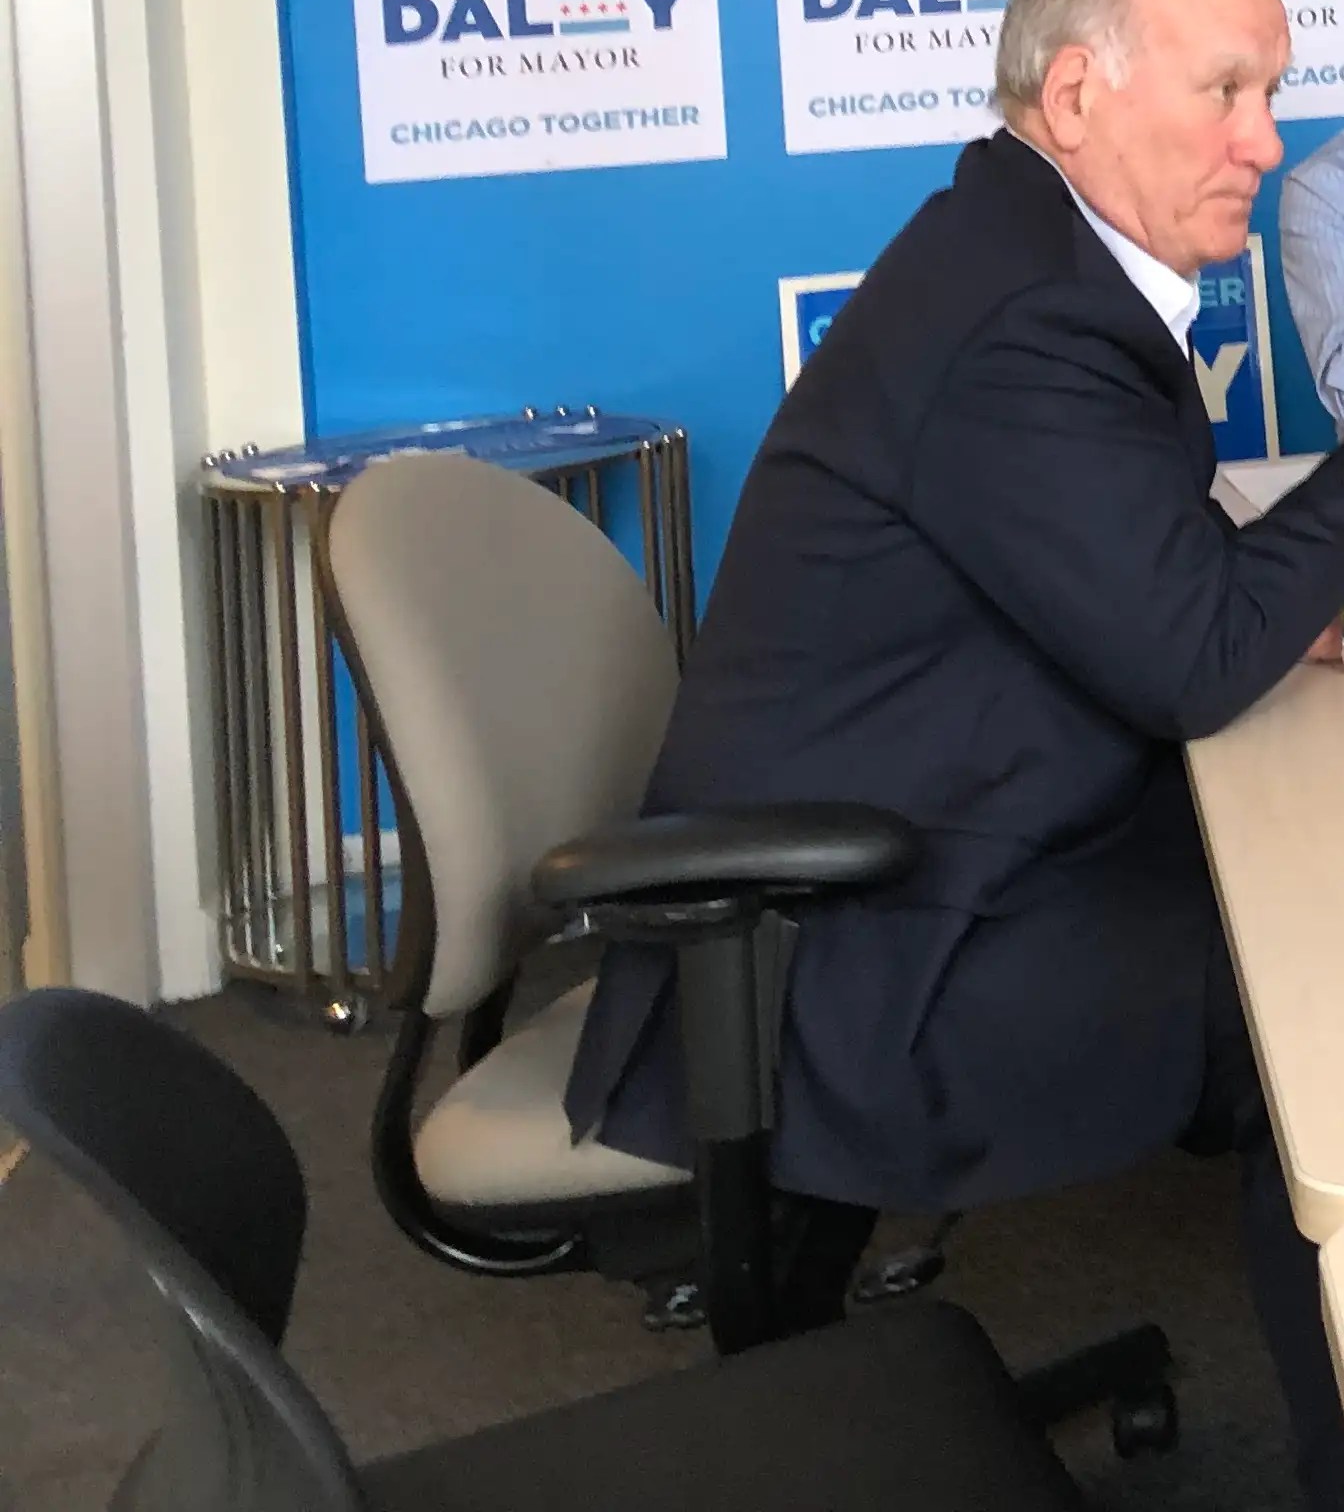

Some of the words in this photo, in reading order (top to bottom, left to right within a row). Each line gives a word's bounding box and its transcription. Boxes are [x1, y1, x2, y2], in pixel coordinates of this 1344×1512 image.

[855, 31, 917, 55] FOR
[929, 24, 996, 50] MAY
[440, 54, 507, 80] FOR
[519, 46, 641, 74] MAYOR
[808, 90, 940, 119] CHICAGO
[390, 115, 531, 145] CHICAGO
[540, 104, 699, 135] TOGETHER
